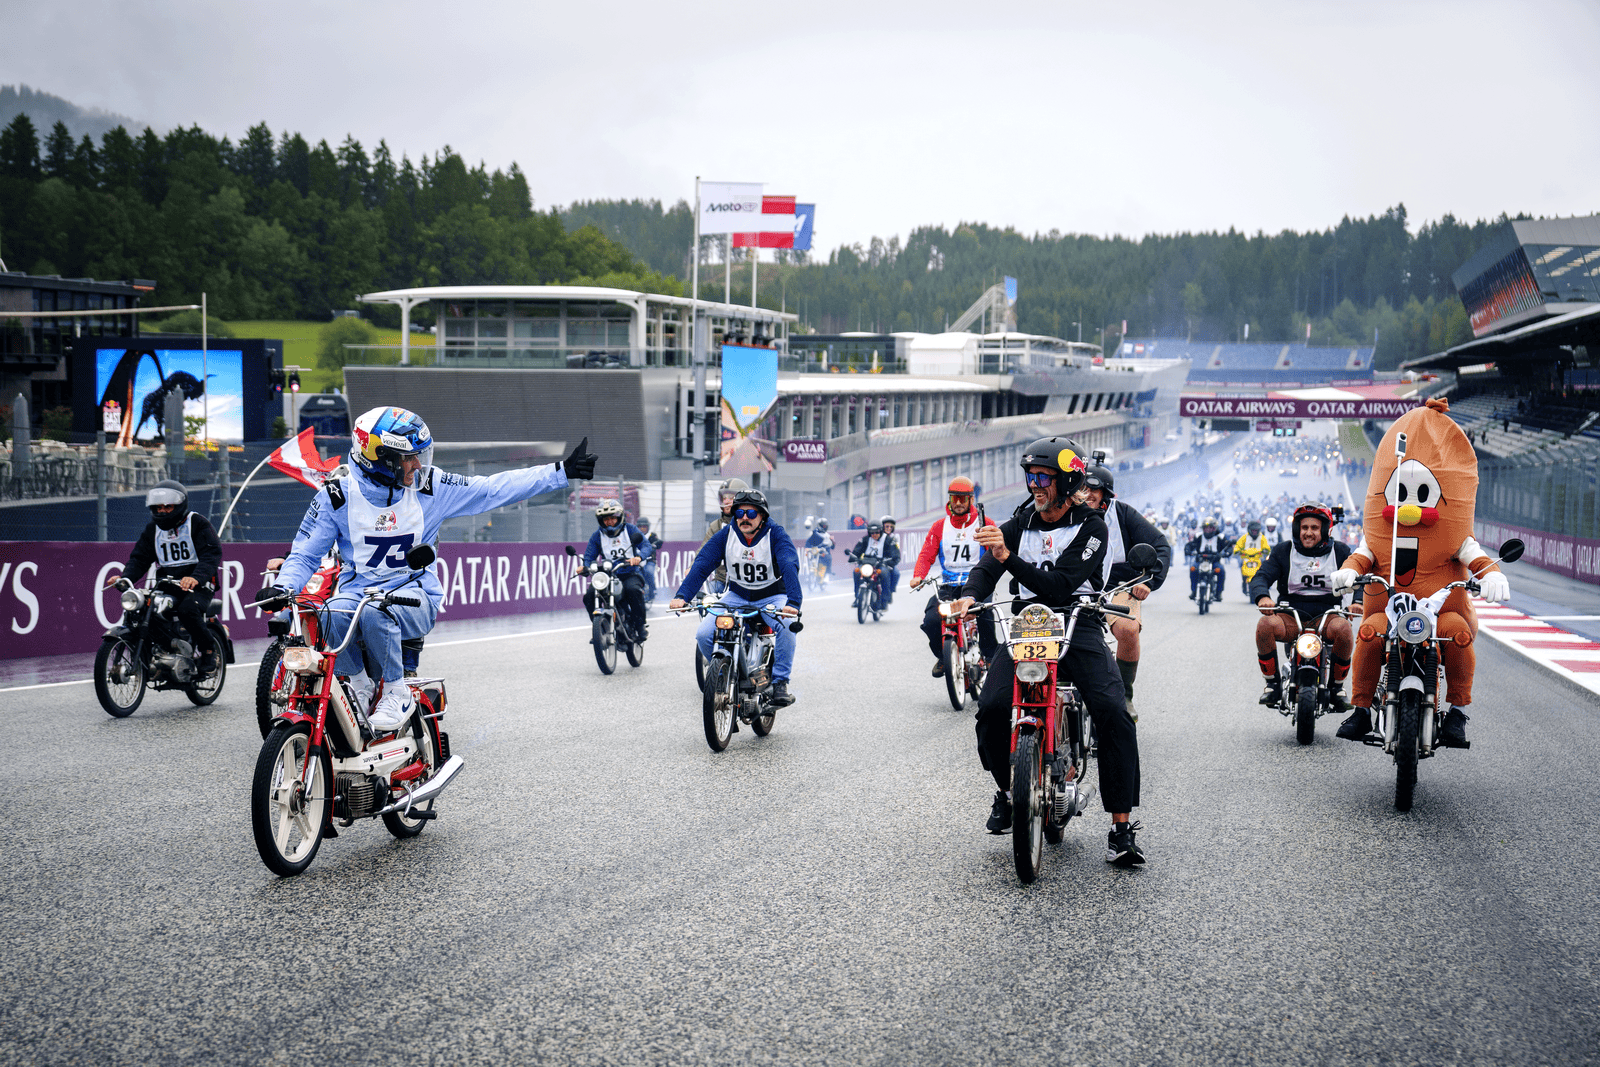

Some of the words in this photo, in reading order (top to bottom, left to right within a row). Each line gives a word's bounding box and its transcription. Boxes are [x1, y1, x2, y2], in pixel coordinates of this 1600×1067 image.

[1185, 401, 1233, 414] QATAR
[1235, 401, 1296, 415] AIRWAYS
[1307, 402, 1355, 415] QATAR
[787, 442, 825, 454] QATAR
[160, 540, 190, 562] 166
[364, 532, 415, 568] 73
[951, 544, 971, 562] 74
[515, 553, 591, 600] AIRWA
[732, 562, 768, 583] 193
[1023, 645, 1048, 659] 32
[316, 702, 325, 730] PUCH
